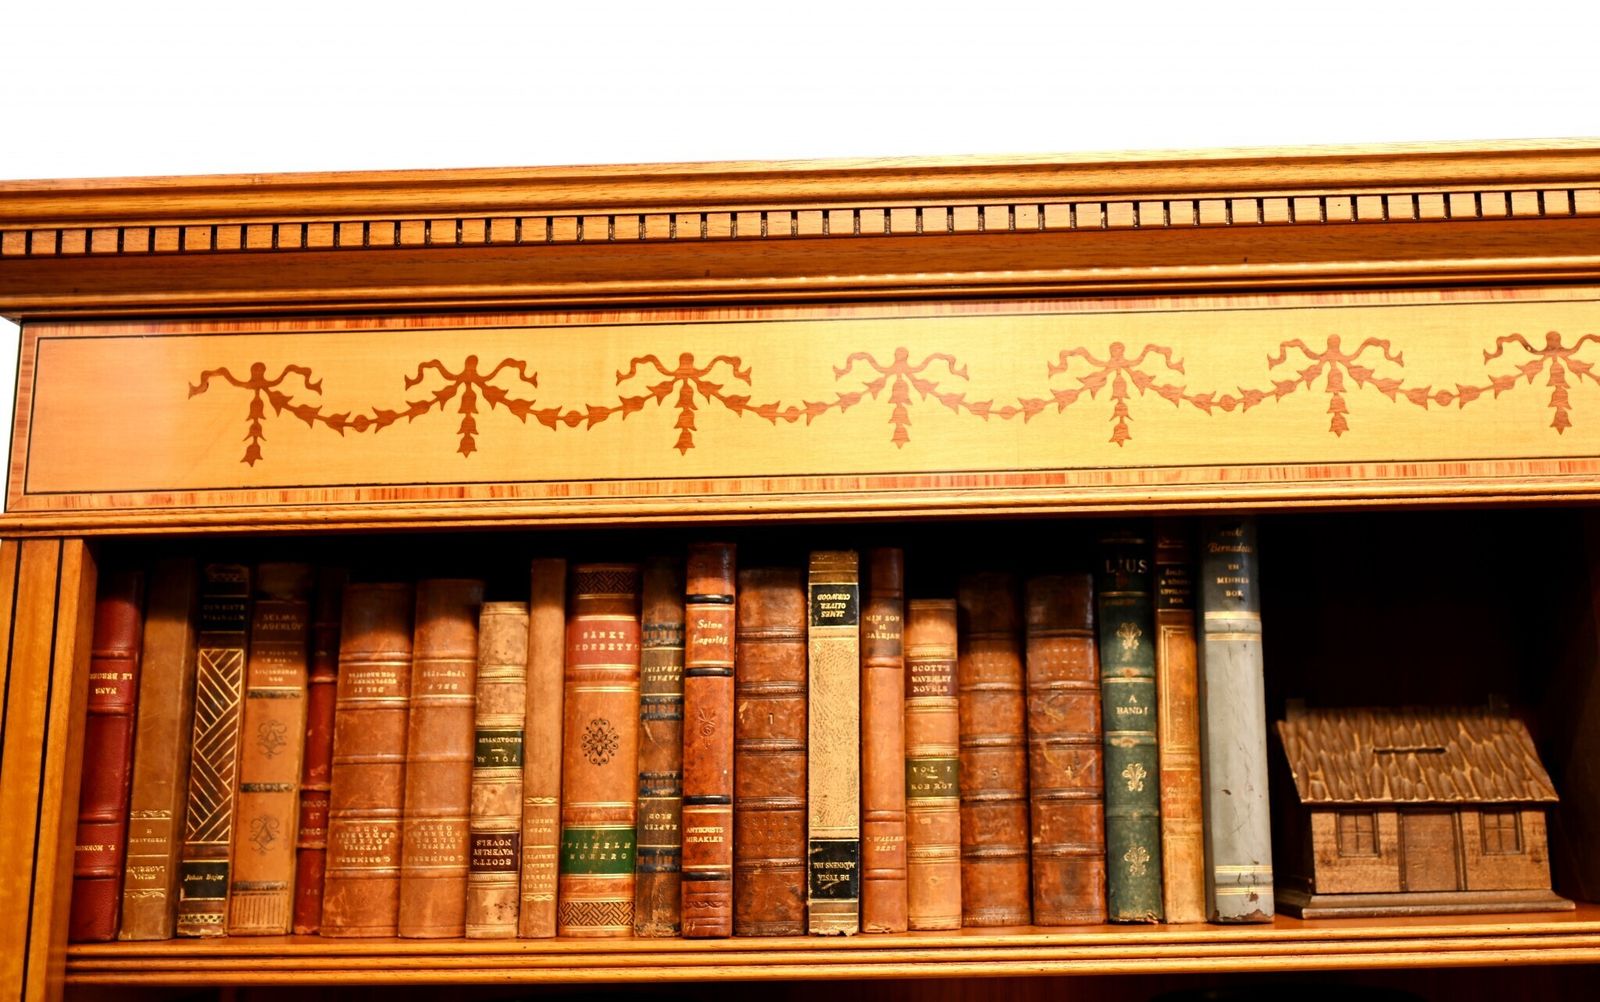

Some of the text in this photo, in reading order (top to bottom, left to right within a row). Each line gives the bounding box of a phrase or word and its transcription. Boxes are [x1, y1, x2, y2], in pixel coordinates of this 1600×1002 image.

[122, 672, 133, 681] LE
[1128, 694, 1138, 703] A
[1116, 706, 1143, 715] BAND
[476, 839, 512, 847] NOVELS
[472, 848, 514, 856] WAVERLEY
